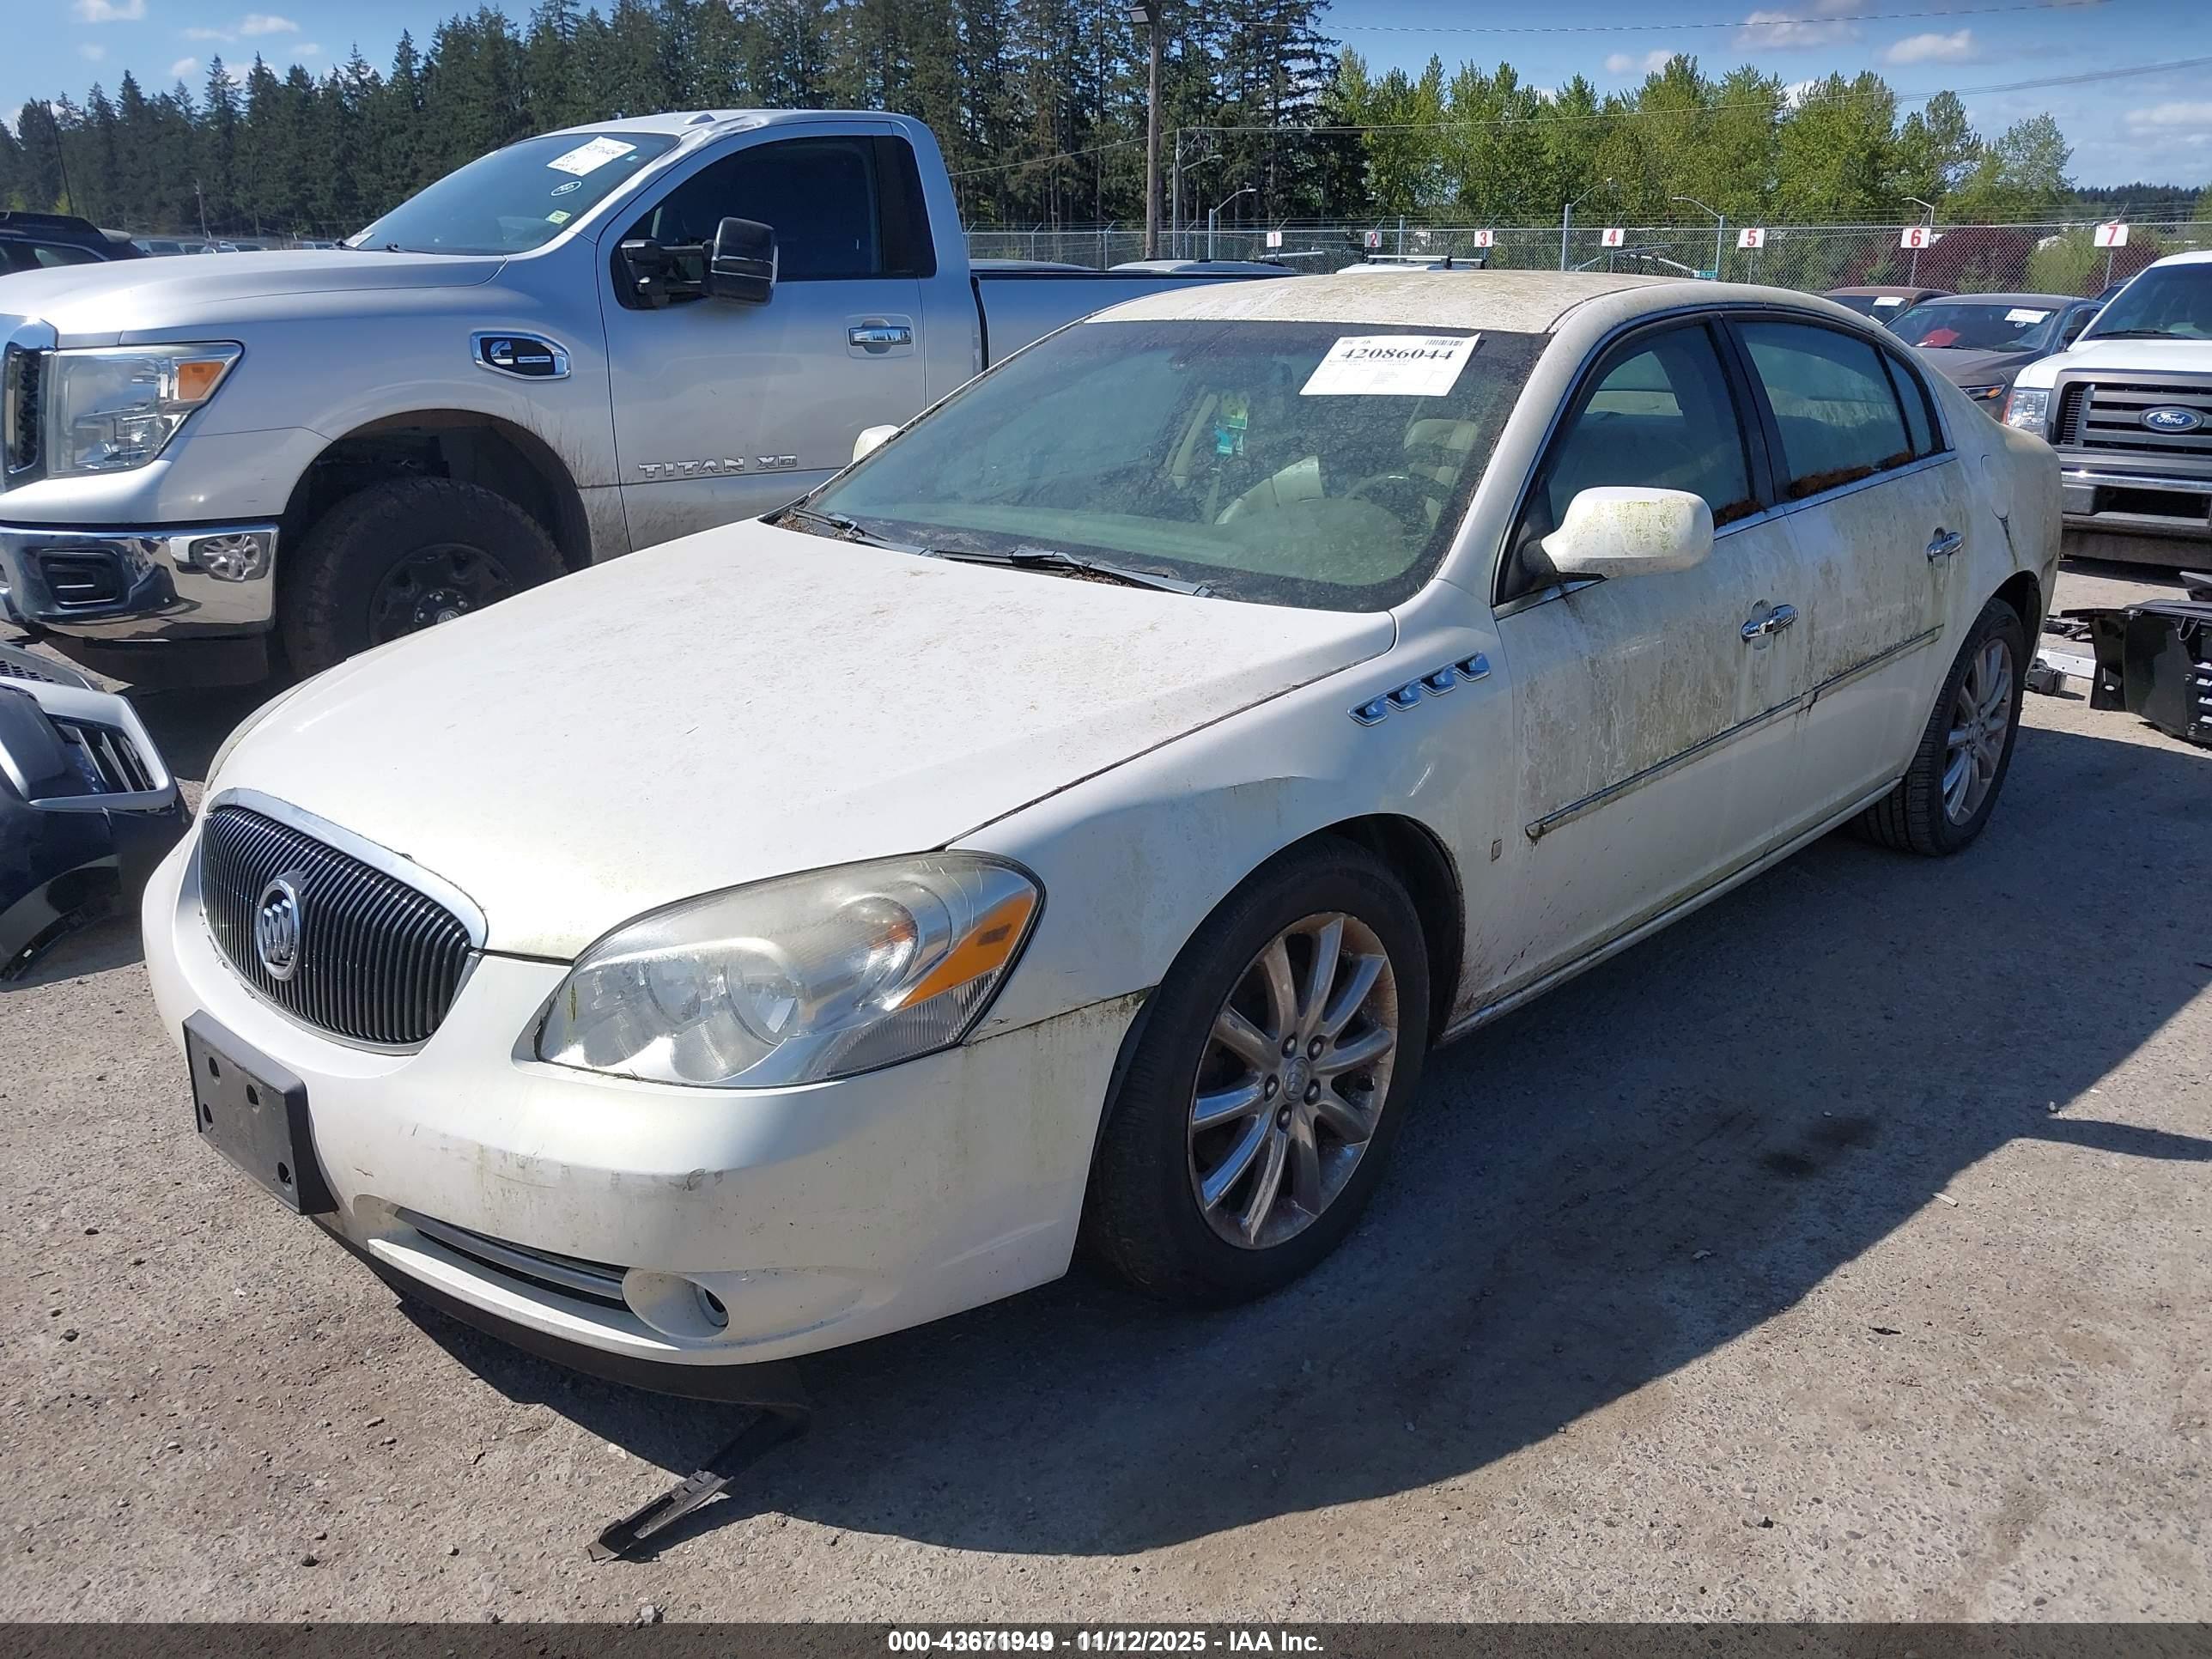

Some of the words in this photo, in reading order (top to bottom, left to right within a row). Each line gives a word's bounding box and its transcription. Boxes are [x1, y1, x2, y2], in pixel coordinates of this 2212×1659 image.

[1272, 233, 1277, 246] 1
[1370, 233, 1377, 246] 2
[1480, 232, 1488, 246] 3
[1607, 229, 1617, 245] 4
[1747, 229, 1757, 246] 5
[1910, 228, 1922, 247] 6
[2107, 226, 2118, 246] 7
[1340, 348, 1455, 360] 42086044
[2156, 412, 2185, 424] Ford
[638, 457, 745, 478] TITAN
[756, 454, 798, 470] XD
